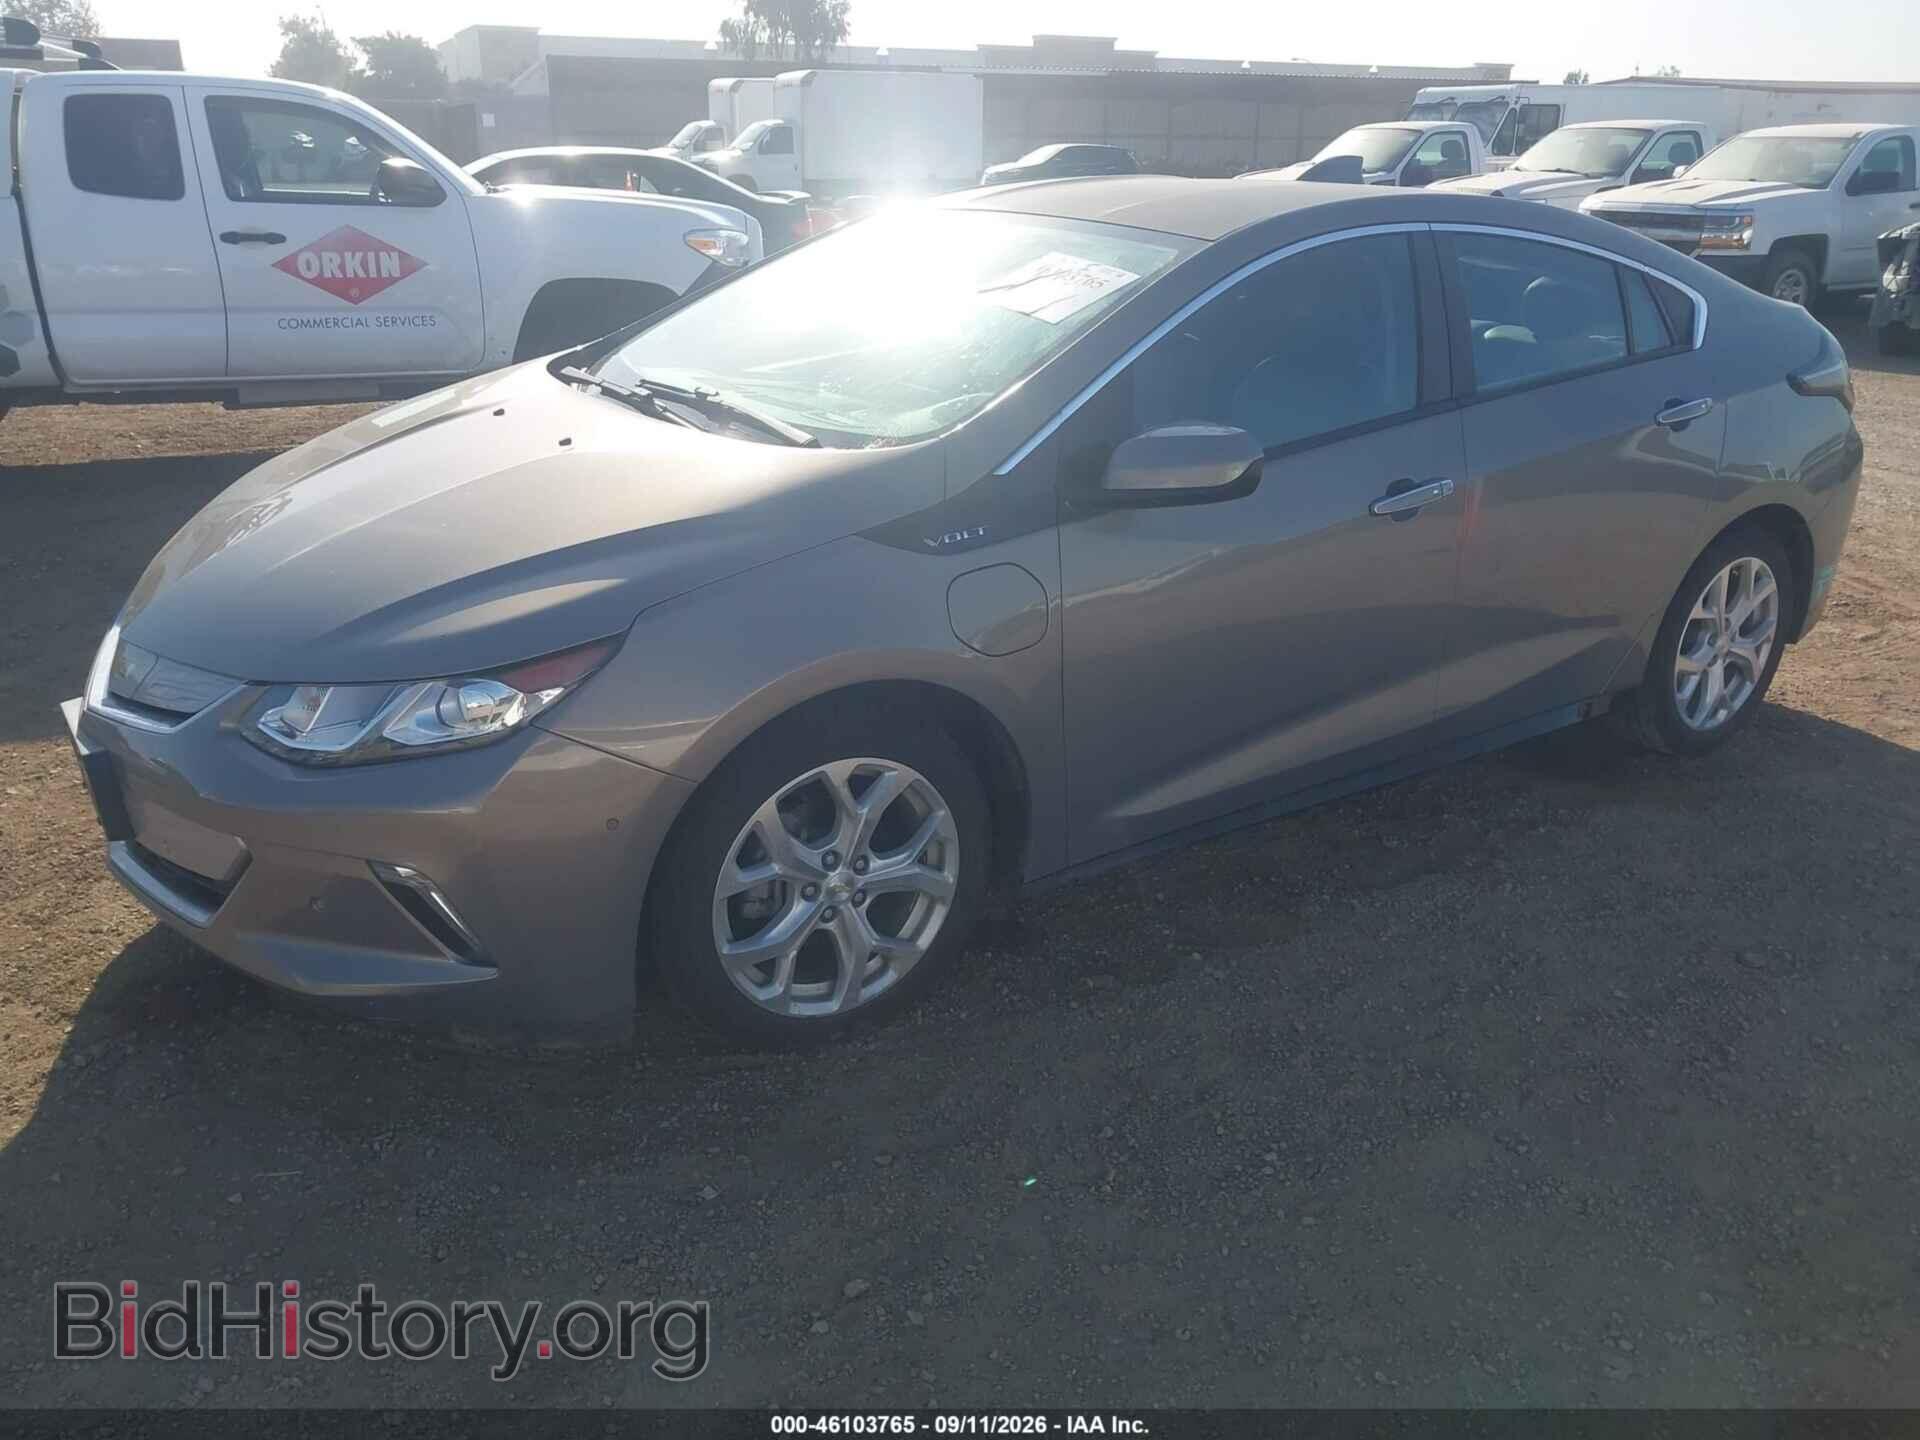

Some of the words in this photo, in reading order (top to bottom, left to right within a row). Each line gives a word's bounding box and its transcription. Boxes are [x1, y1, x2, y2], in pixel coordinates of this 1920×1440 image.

[297, 251, 401, 279] ORKIN
[277, 316, 370, 330] COMMERCIAL
[375, 315, 436, 328] SERVICES
[923, 527, 986, 547] VOLT
